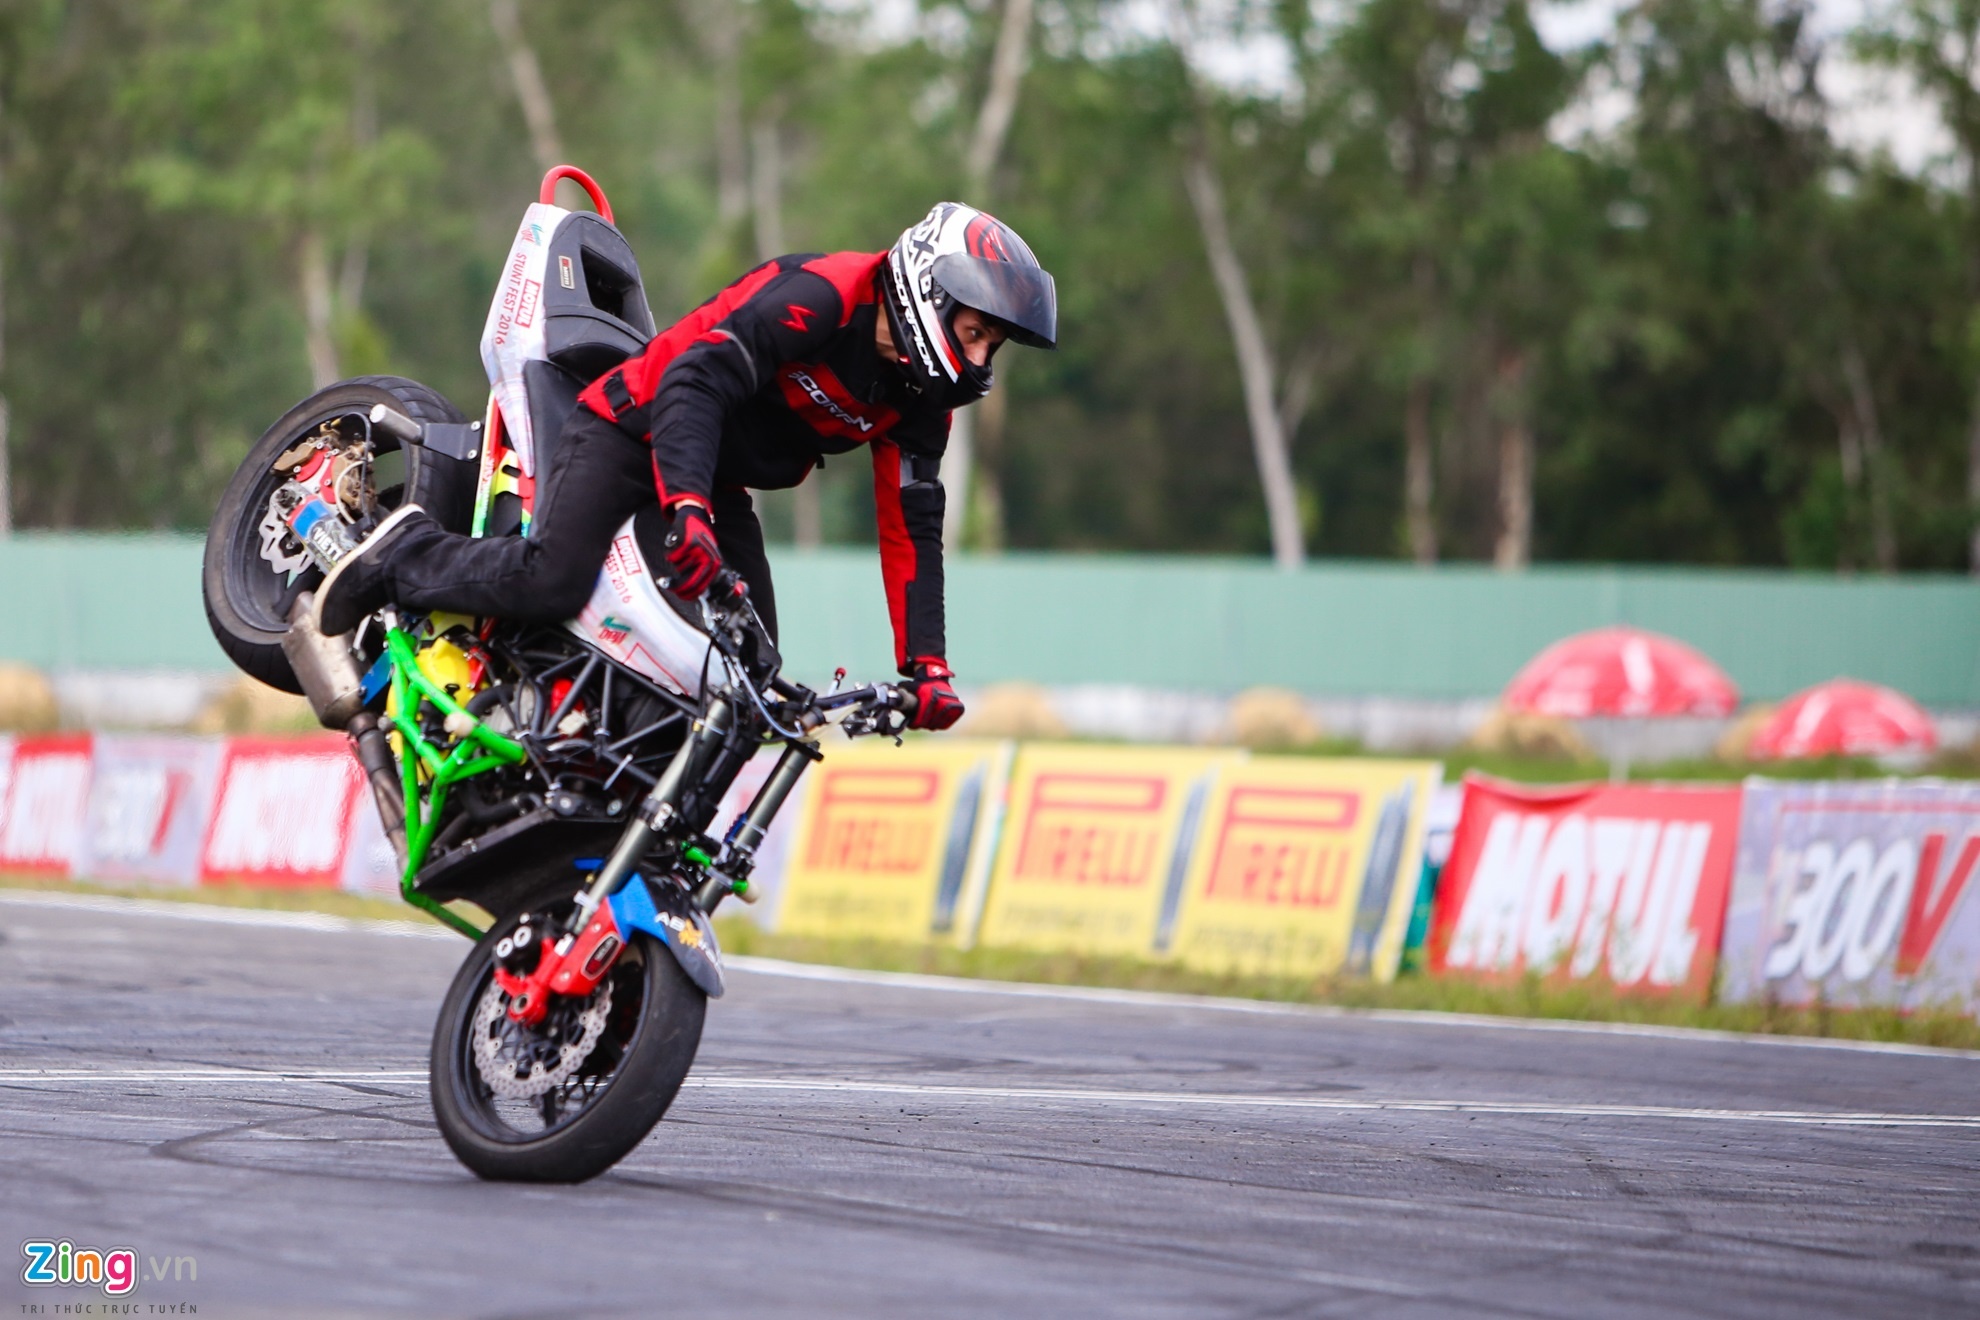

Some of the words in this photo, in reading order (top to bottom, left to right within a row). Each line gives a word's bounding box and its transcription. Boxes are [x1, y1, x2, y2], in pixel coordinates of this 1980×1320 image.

[510, 252, 527, 285] STUNT
[502, 287, 519, 312] FEST
[516, 280, 541, 328] MOTUL
[891, 252, 940, 377] SCORPION
[495, 314, 511, 345] 2016
[615, 536, 641, 575] MOTUL
[612, 576, 633, 603] 2016
[1442, 812, 1714, 987] MOTUL
[1763, 834, 1980, 982] 300V
